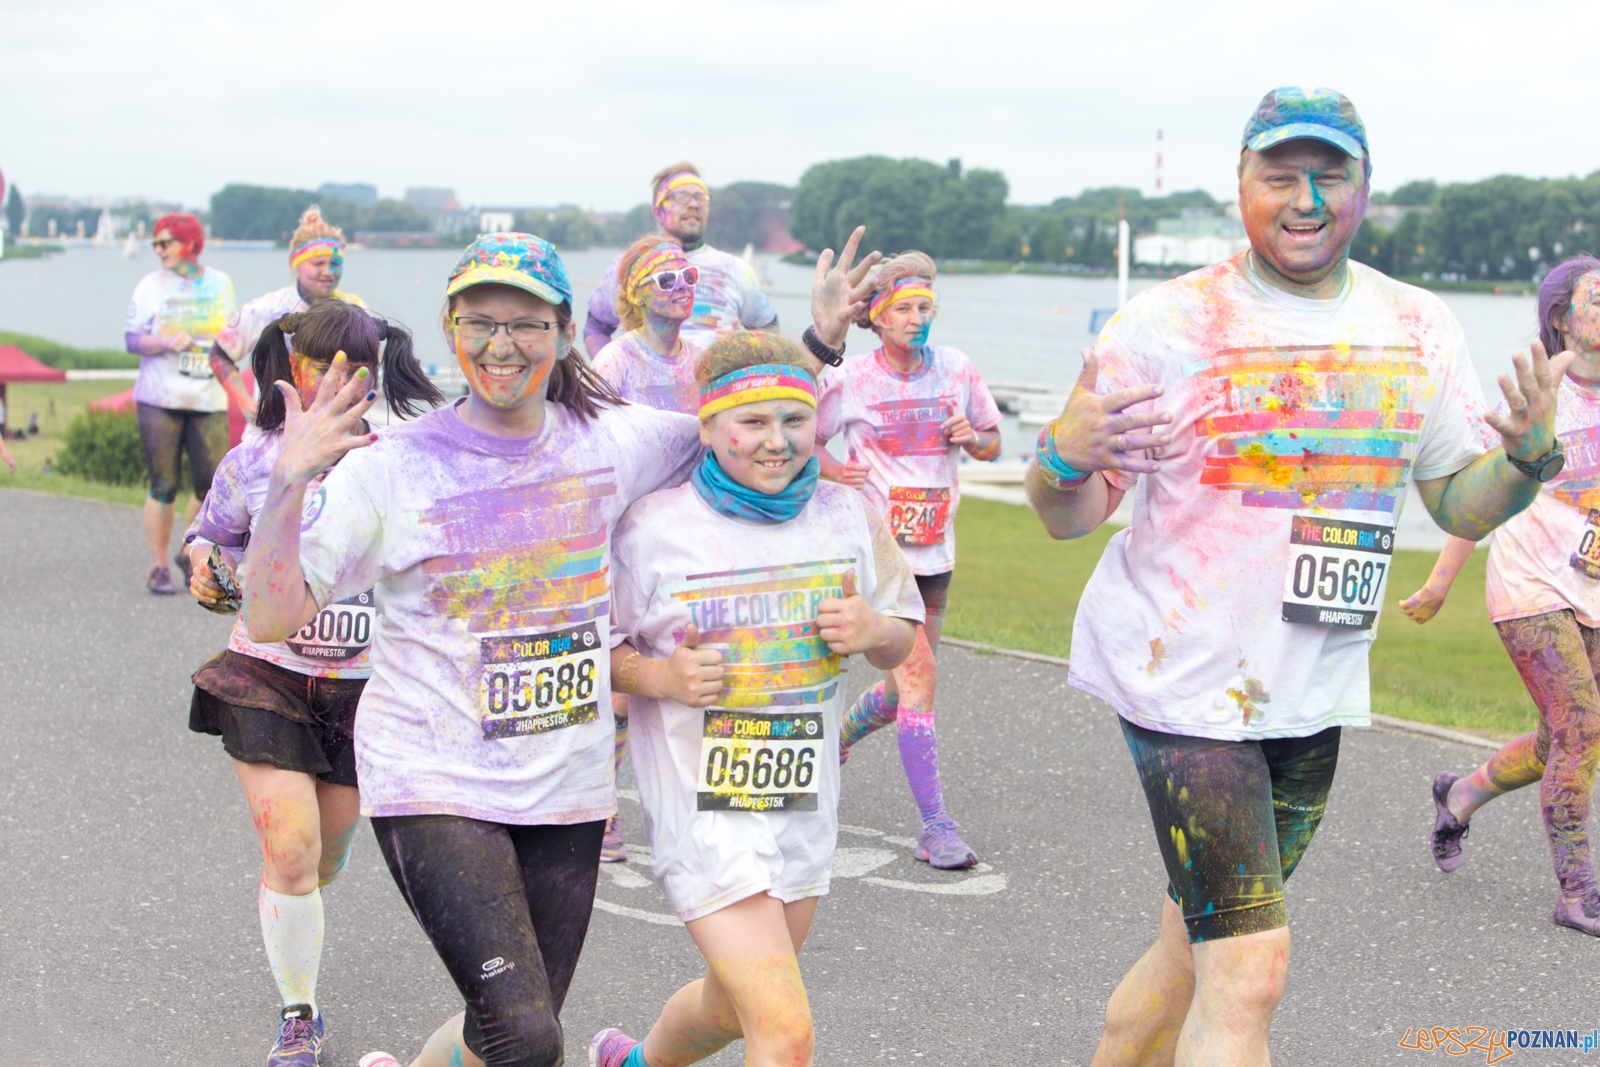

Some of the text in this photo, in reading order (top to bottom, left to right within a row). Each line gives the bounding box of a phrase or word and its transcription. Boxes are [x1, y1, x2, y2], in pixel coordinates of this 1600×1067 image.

[1301, 523, 1375, 548] THE COLOR RUN
[1292, 553, 1386, 606] 05687
[287, 609, 370, 643] 3000
[687, 601, 731, 630] THE
[734, 590, 807, 628] COLOR
[301, 645, 346, 658] #HAPPIEST5K
[490, 636, 571, 660] TE COLOR RUN
[487, 658, 595, 715] 05688
[712, 718, 793, 736] THE COLOR RUN
[705, 746, 815, 789] 05686
